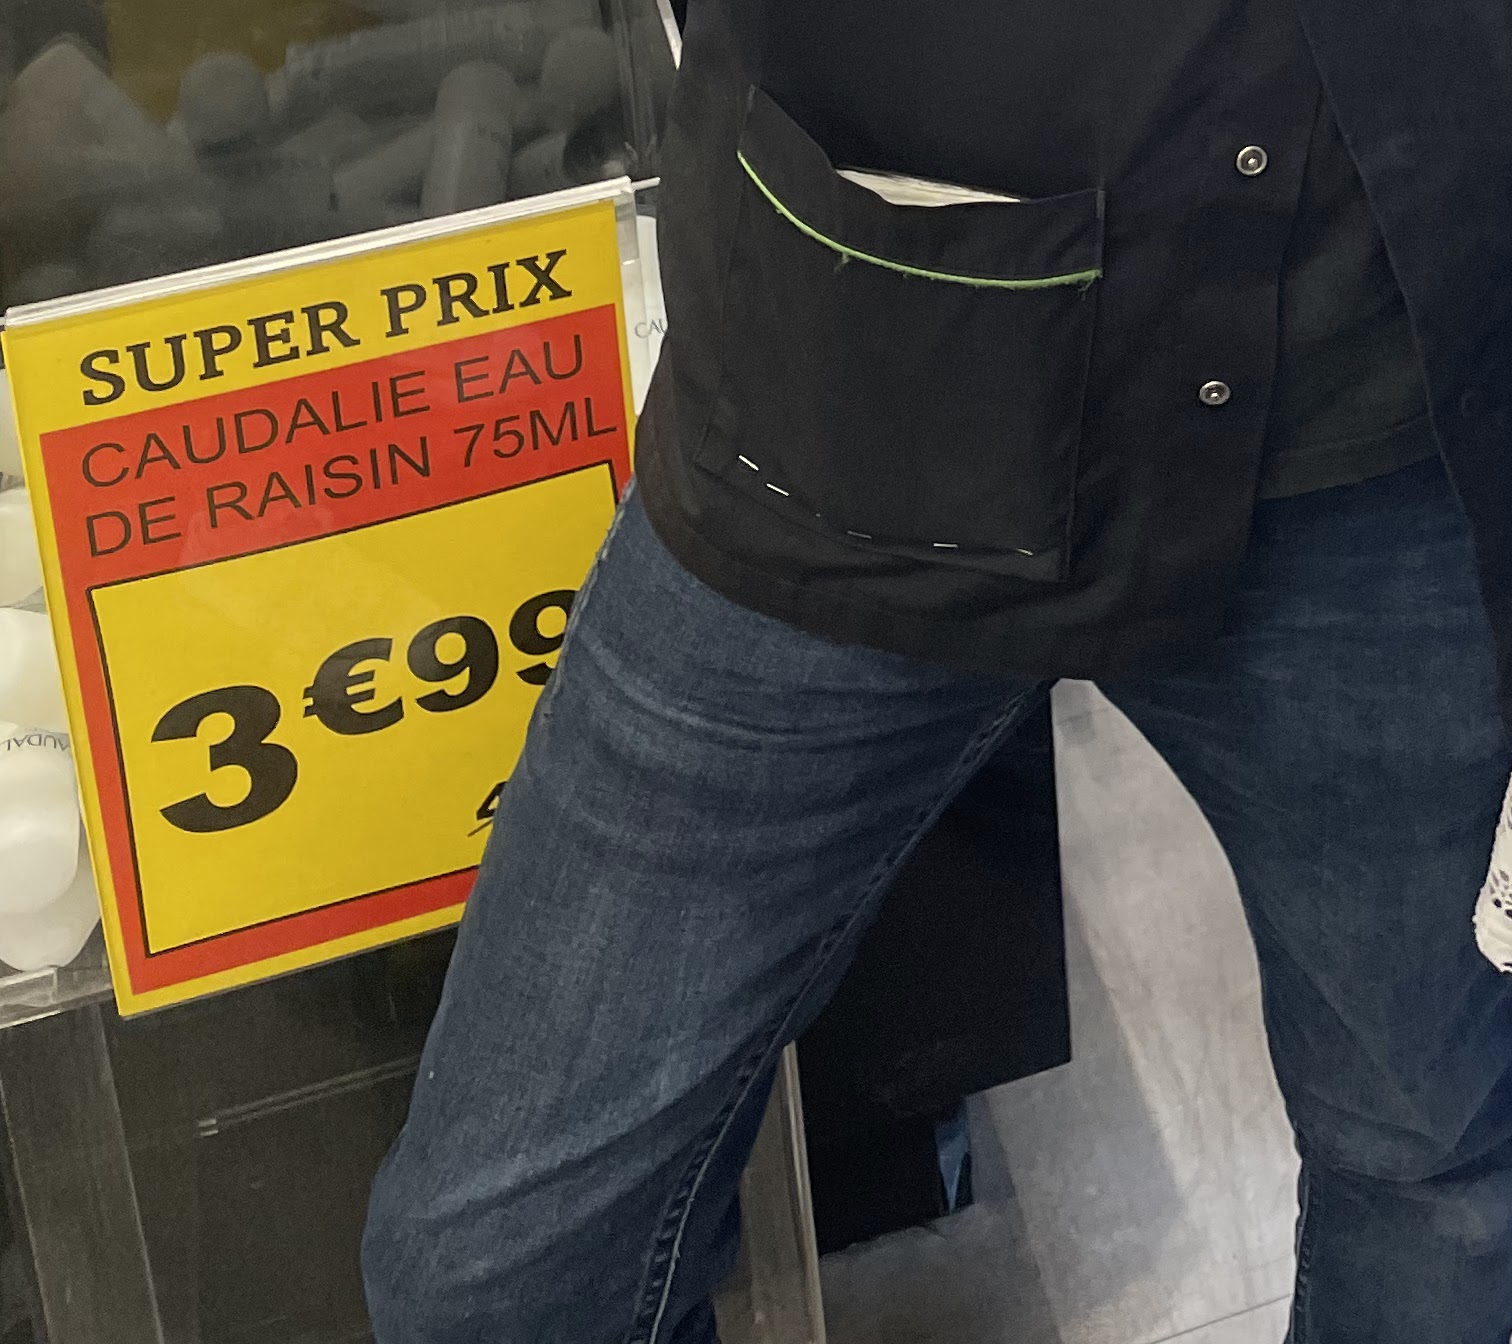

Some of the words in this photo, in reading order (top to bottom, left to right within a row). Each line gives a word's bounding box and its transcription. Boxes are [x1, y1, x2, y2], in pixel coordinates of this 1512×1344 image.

[79, 299, 359, 407] SUPER
[380, 248, 573, 338] PRIX
[80, 370, 432, 489] CAUDALIE
[454, 333, 584, 406] EAU
[87, 494, 182, 558] DE
[207, 437, 433, 530] RAISIN
[453, 396, 618, 469] 75ML
